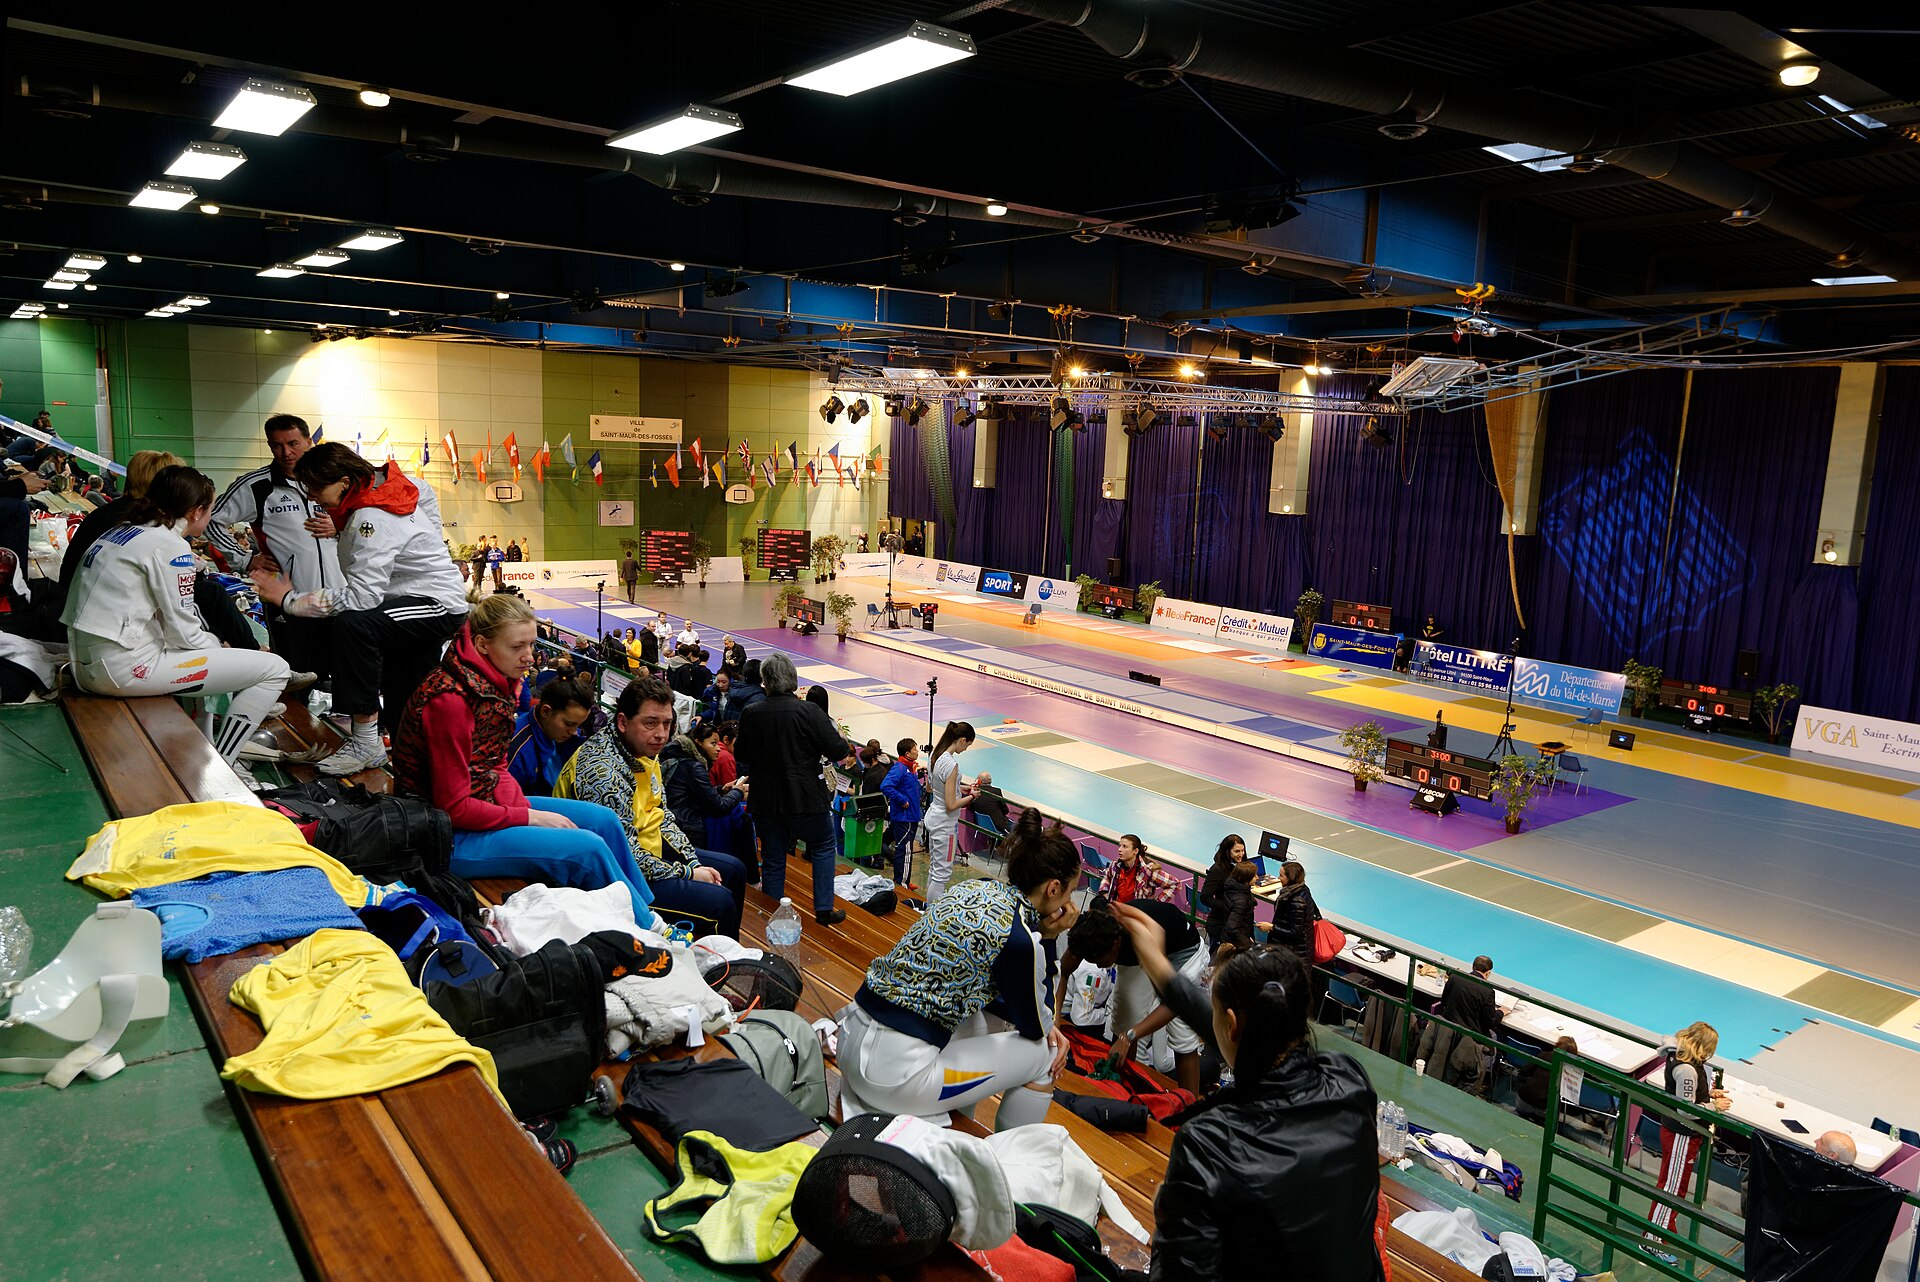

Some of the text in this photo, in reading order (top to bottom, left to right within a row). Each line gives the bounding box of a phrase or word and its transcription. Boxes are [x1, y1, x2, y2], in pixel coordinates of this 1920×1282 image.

[268, 504, 300, 514] VOITH
[503, 572, 535, 581] rance
[985, 577, 1012, 591] SPORT
[1222, 615, 1289, 636] Crédit Mutuel
[1350, 616, 1356, 625] 0
[1368, 619, 1374, 627] 0
[1456, 652, 1506, 672] LITTRÉ
[1560, 671, 1613, 691] Département
[994, 669, 1028, 683] CHALLENGE
[1030, 677, 1082, 698] INTERNATIONAL
[1085, 693, 1093, 701] DE
[1096, 695, 1116, 708] SAINT
[1119, 702, 1142, 713] MAUR
[1550, 685, 1616, 708] du Val-de-Marne
[1698, 685, 1717, 694] 3:00
[1688, 699, 1697, 711] 0
[1714, 704, 1724, 715] 0
[1804, 717, 1859, 748] VGA
[1430, 750, 1451, 762] 3:00
[1881, 743, 1920, 759] Escrim
[1418, 768, 1428, 783] 0
[1449, 776, 1459, 791] 0
